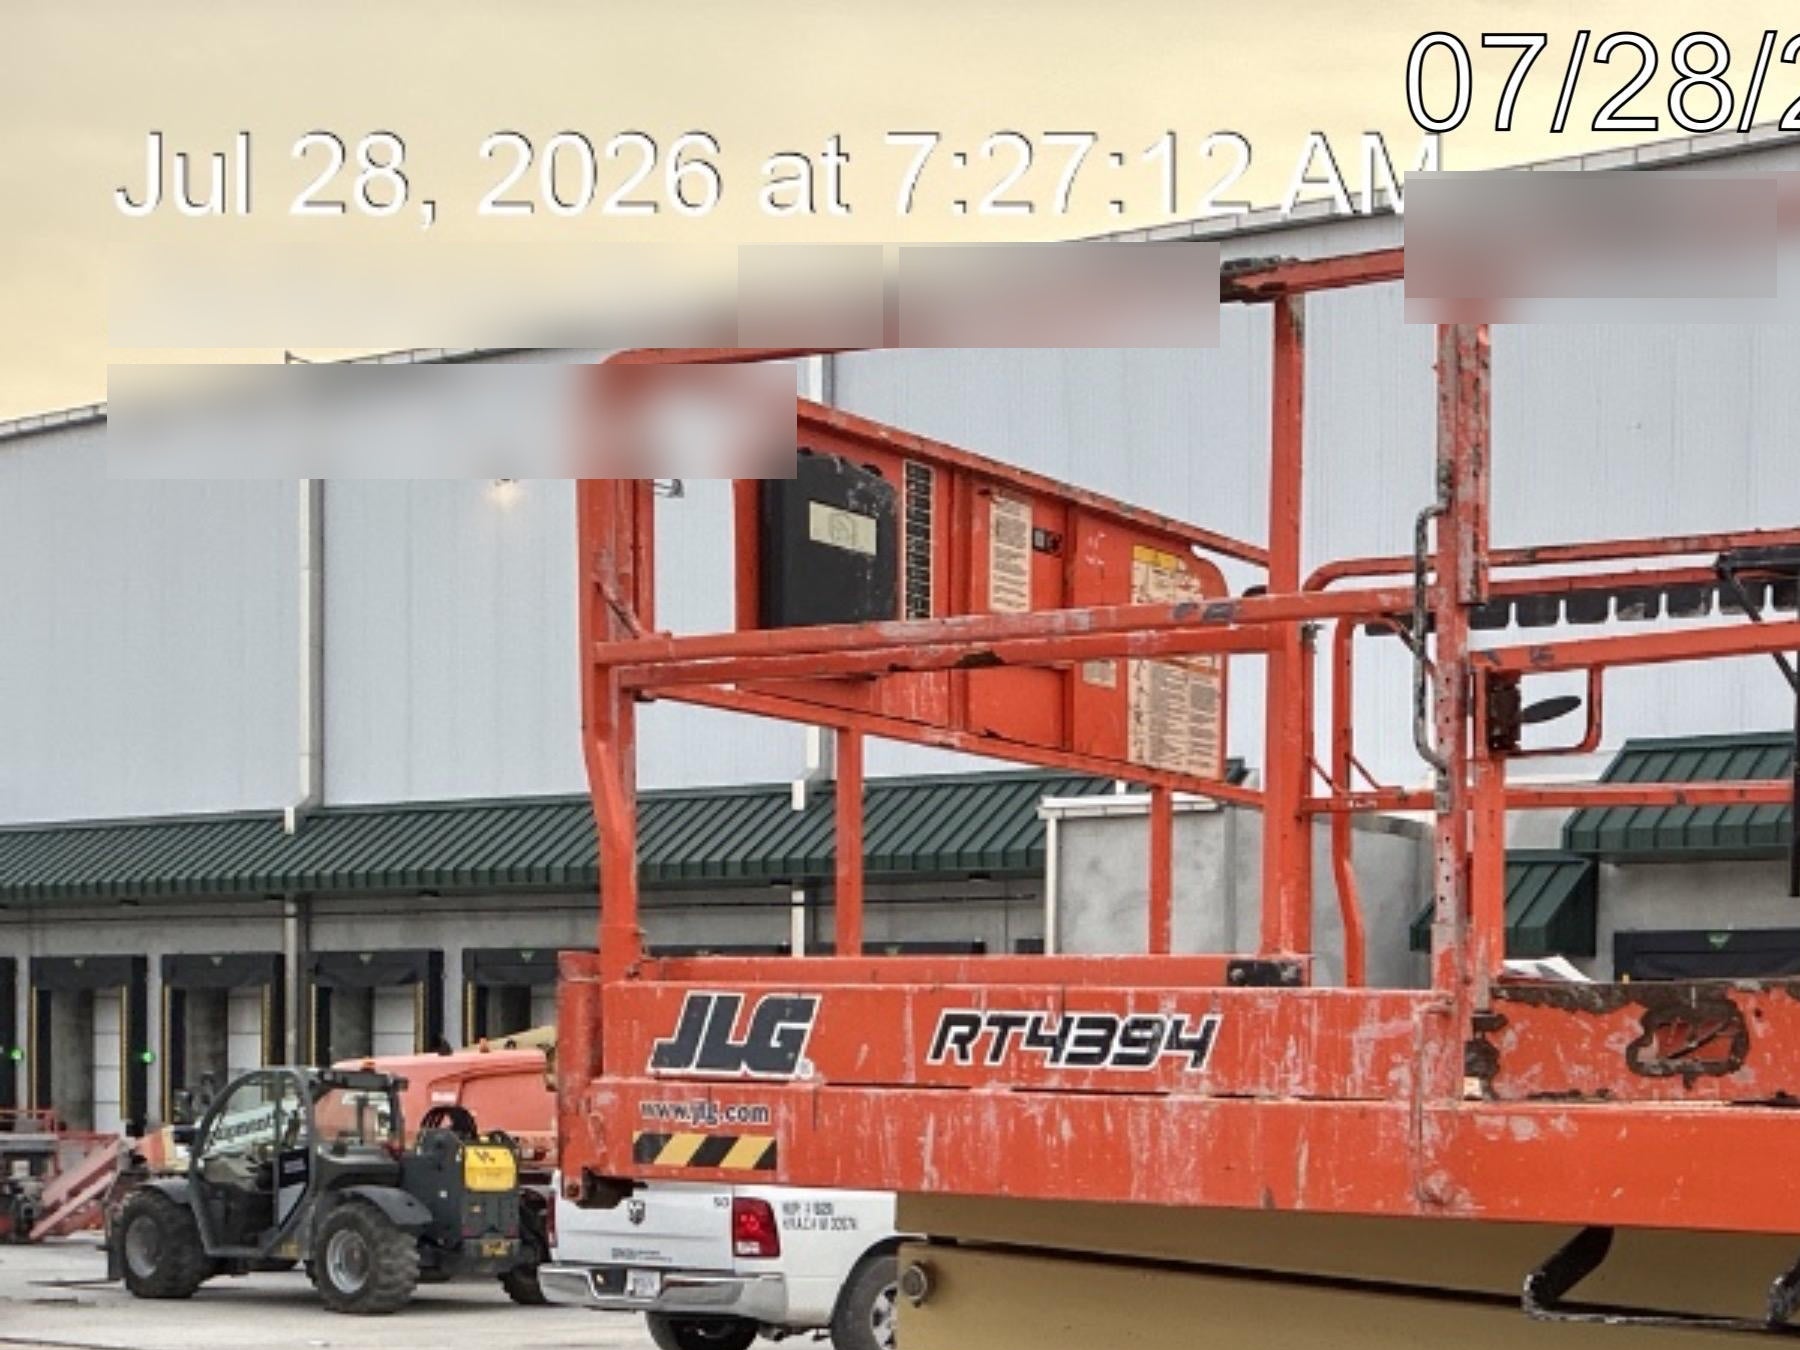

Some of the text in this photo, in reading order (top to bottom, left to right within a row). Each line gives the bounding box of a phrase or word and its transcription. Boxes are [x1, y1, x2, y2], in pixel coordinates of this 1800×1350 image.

[647, 990, 822, 1080] JLG
[926, 1008, 1224, 1073] RT4394
[640, 1099, 770, 1127] www.jlg.com
